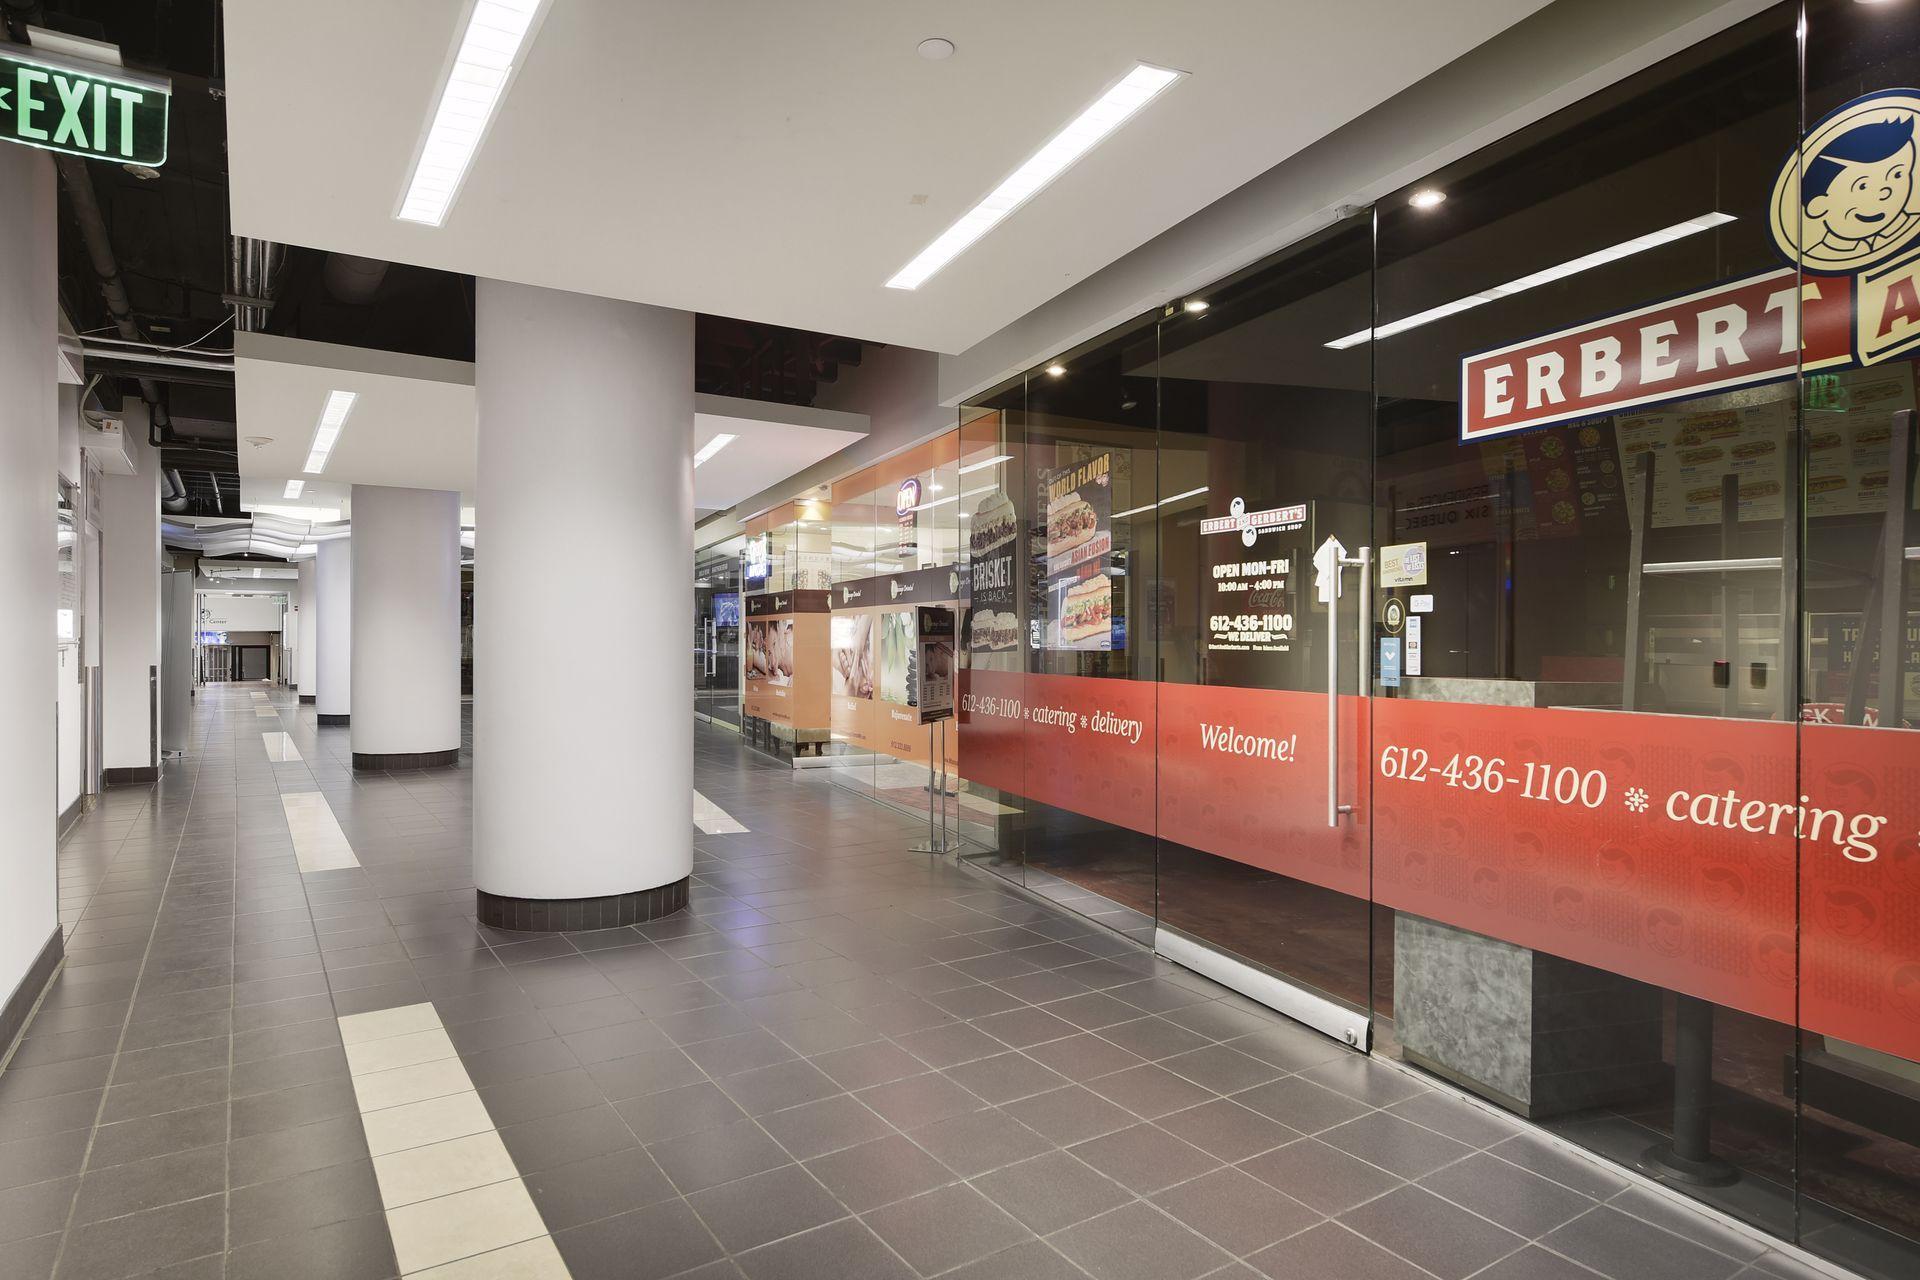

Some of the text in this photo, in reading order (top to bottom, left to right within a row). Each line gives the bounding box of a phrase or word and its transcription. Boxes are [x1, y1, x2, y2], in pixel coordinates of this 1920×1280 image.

[17, 66, 143, 156] EXIT
[1483, 281, 1823, 420] ERBERT
[1049, 453, 1110, 501] WORLD FLAVOR
[897, 486, 915, 511] OPEN
[1202, 517, 1236, 532] ERBERT
[1251, 508, 1303, 526] GERBERT'S
[1258, 523, 1303, 535] SANDWICH SHOP
[1071, 546, 1088, 564] ASIAN
[973, 555, 1012, 592] BRISKET
[1212, 558, 1290, 579] OPEN MON-FRI
[980, 589, 1006, 602] IS BACK
[1217, 581, 1237, 592] 10:00
[1237, 582, 1248, 591] AM
[1254, 580, 1272, 591] 4:00
[1272, 580, 1285, 589] PM
[1210, 613, 1293, 631] 612-436-1100
[1227, 632, 1272, 642] WE DELIVER
[962, 693, 1143, 744] 612-436-1100 catering delivery
[1200, 722, 1297, 763] Welcome!
[1380, 745, 1888, 863] 612-436-1100 catering
